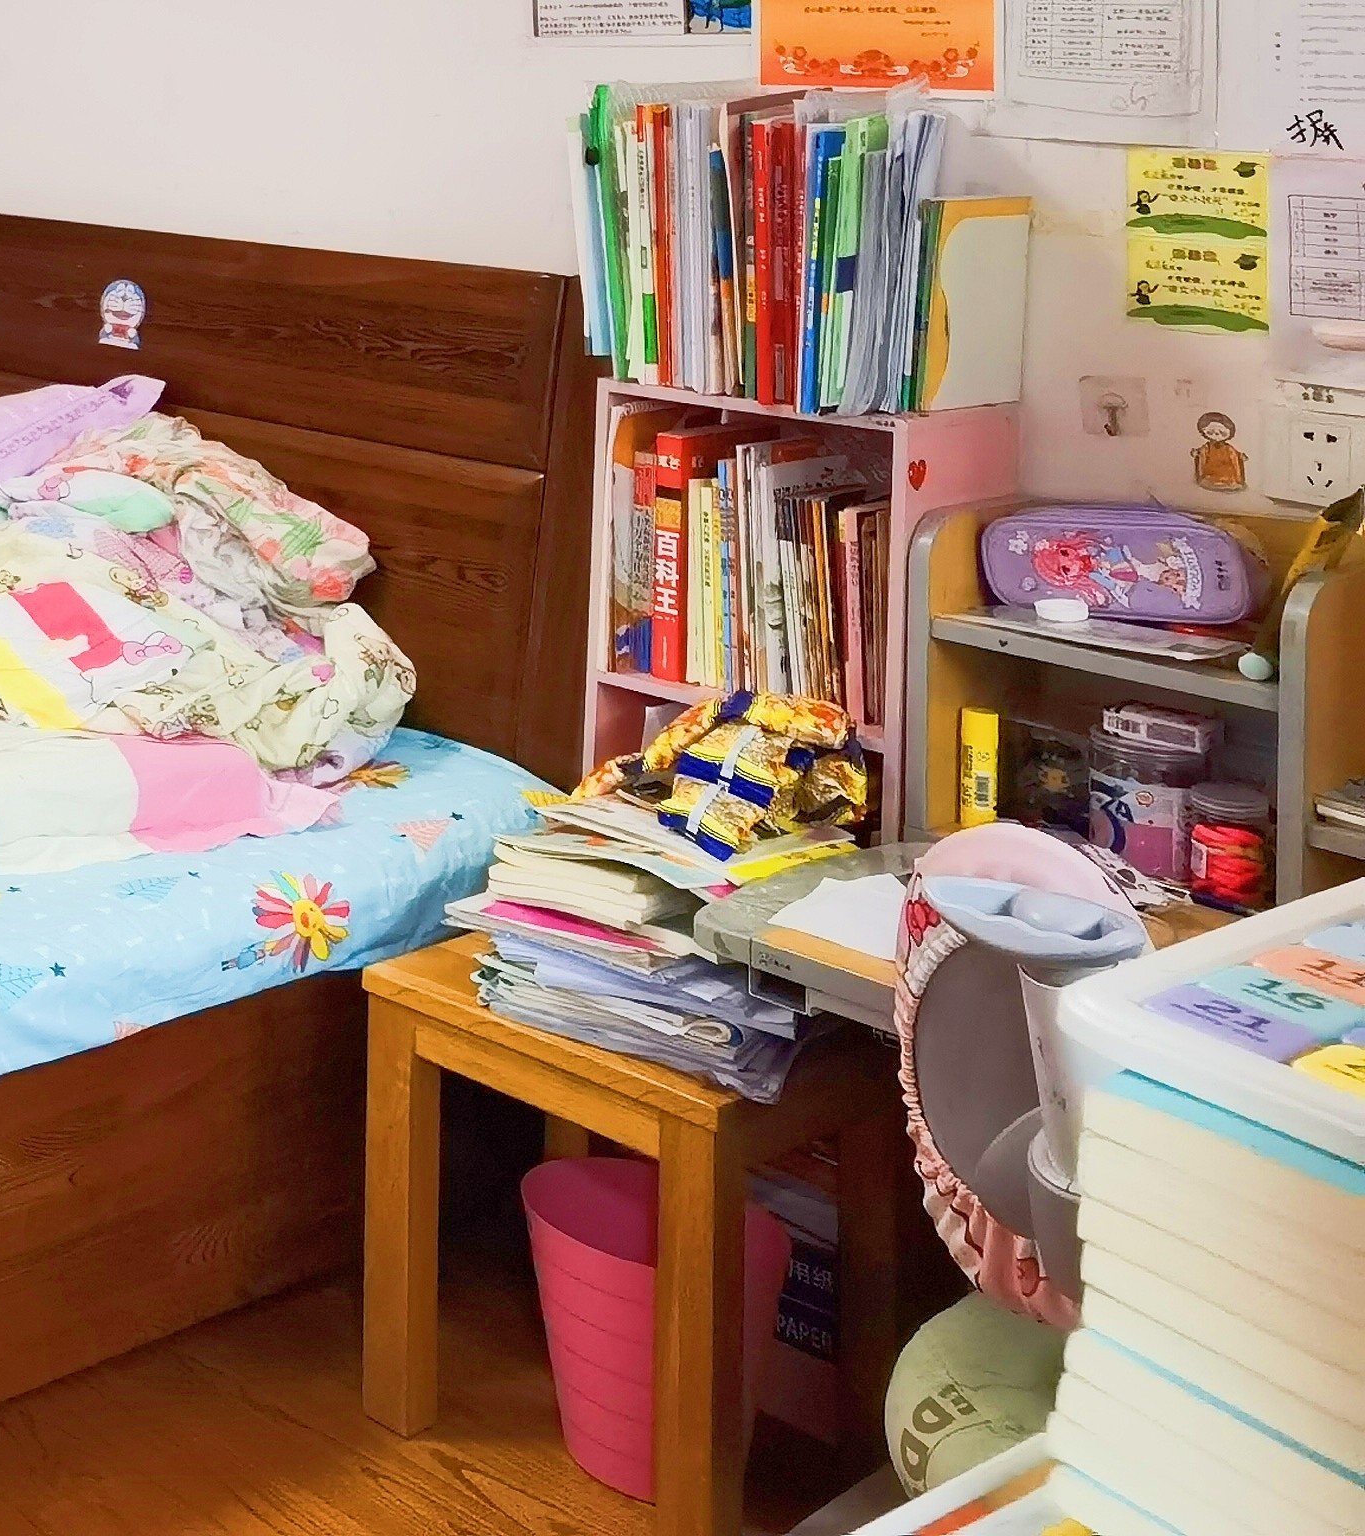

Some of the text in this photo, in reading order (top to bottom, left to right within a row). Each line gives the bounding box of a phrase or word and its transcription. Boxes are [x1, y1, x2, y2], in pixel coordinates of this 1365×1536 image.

[654, 529, 681, 616] 百科王
[1245, 978, 1333, 1010] 16
[1193, 999, 1271, 1034] 21
